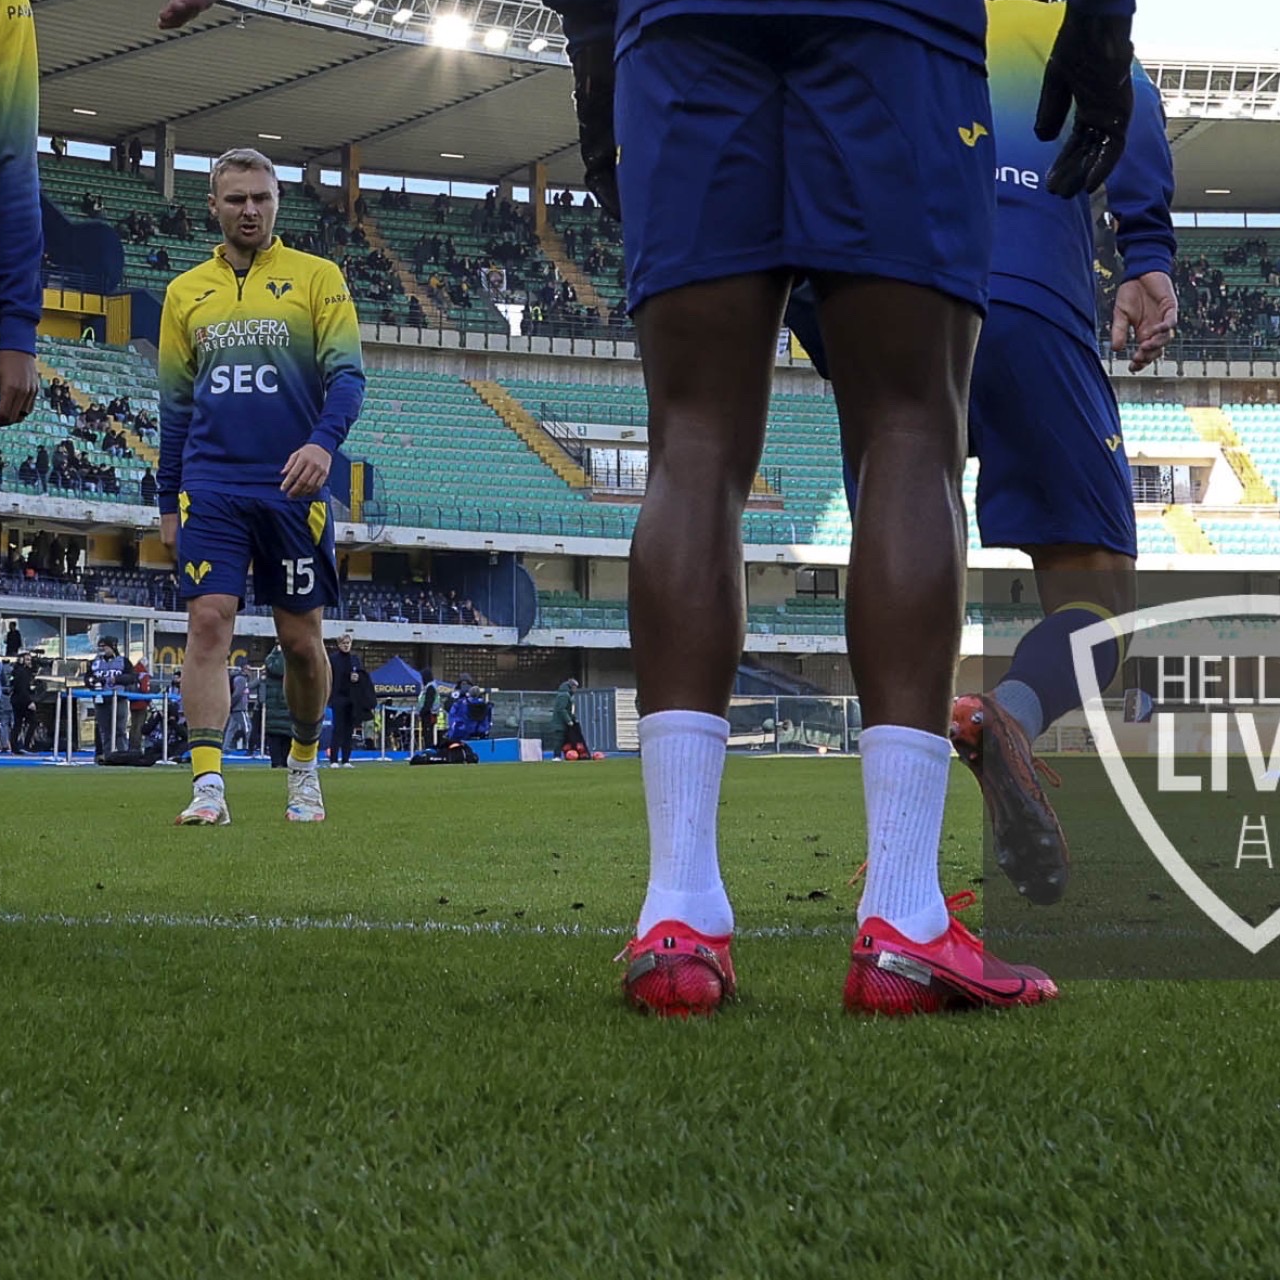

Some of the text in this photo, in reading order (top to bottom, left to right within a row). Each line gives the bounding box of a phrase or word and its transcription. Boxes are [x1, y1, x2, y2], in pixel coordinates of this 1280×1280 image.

[206, 319, 290, 340] SCALIGERA
[201, 334, 290, 352] RREDAMENTI
[210, 364, 279, 395] SEC
[281, 557, 315, 595] 15
[374, 684, 403, 693] ERONA
